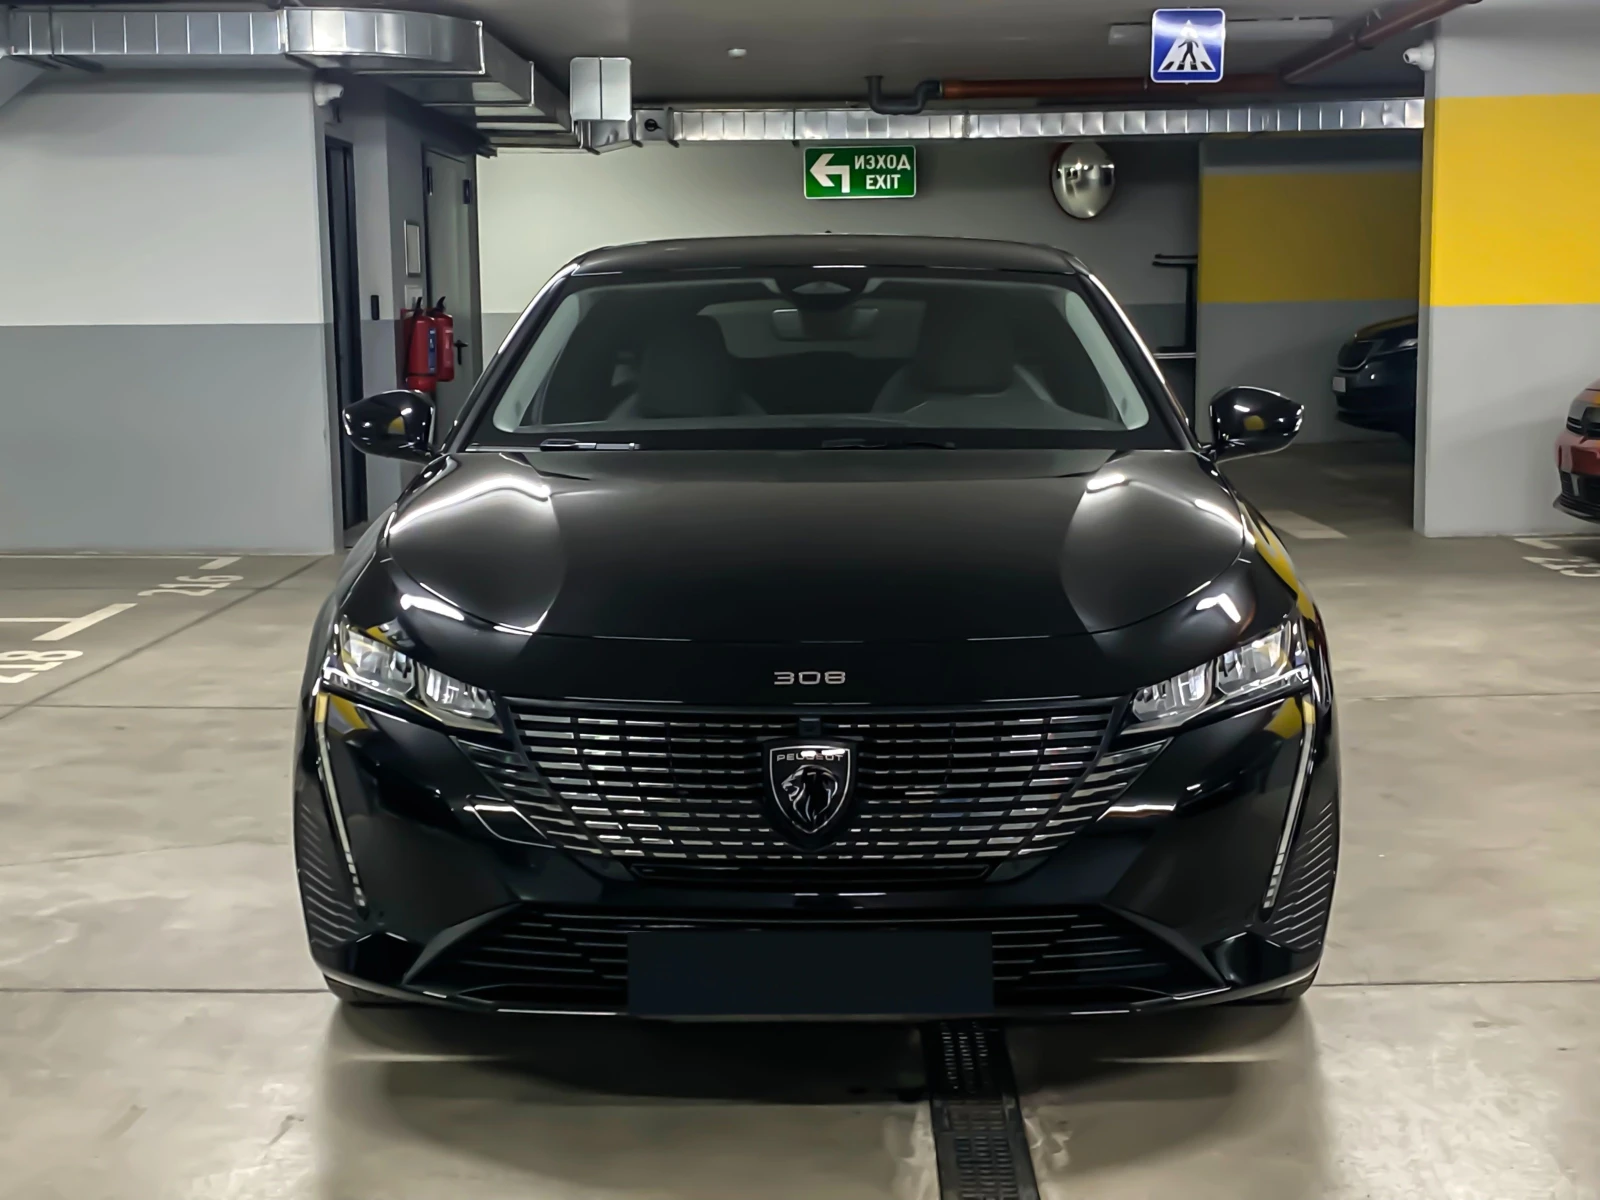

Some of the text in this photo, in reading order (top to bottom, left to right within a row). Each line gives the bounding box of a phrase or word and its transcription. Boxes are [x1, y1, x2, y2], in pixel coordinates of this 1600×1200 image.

[854, 154, 911, 170] ИЗХОД
[865, 174, 901, 189] EXIT
[137, 575, 244, 597] 216
[774, 671, 846, 684] 308
